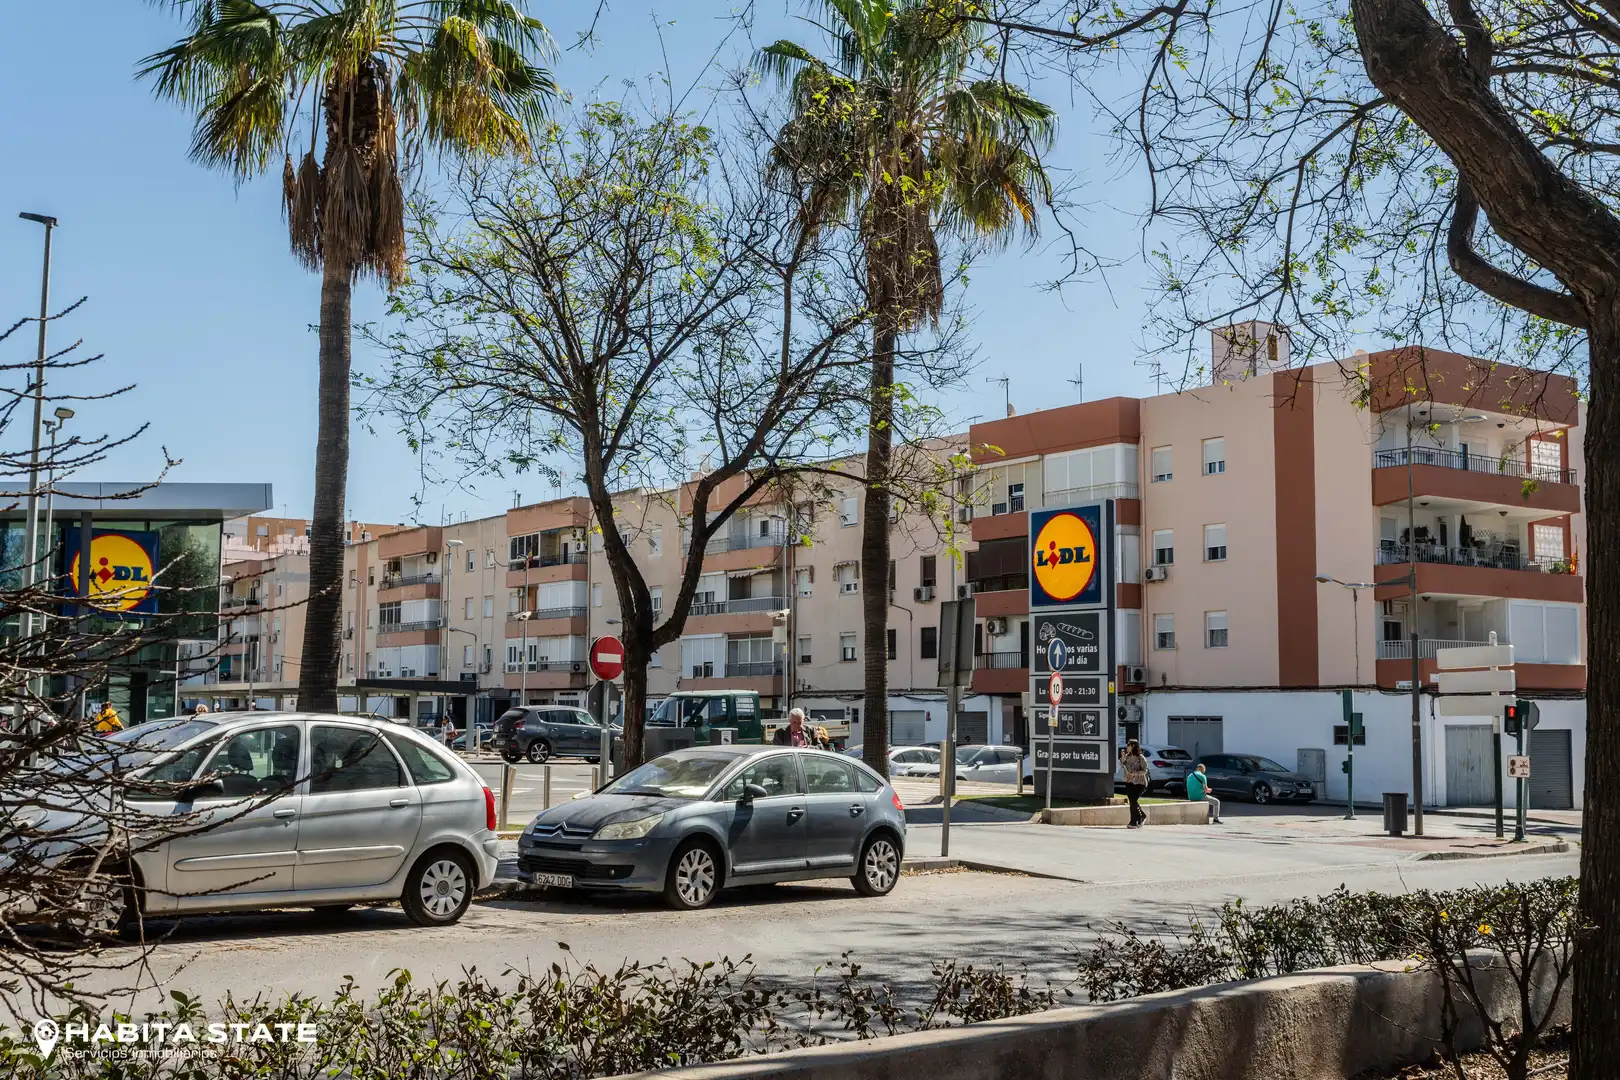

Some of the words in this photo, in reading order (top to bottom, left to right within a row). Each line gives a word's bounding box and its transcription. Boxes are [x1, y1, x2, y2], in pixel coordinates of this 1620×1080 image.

[1076, 644, 1098, 653] varias
[1068, 656, 1075, 665] al
[1053, 684, 1060, 694] 10
[1037, 750, 1060, 759] Graas
[1061, 752, 1071, 761] por
[1073, 751, 1080, 760] tu
[1081, 751, 1099, 761] visita
